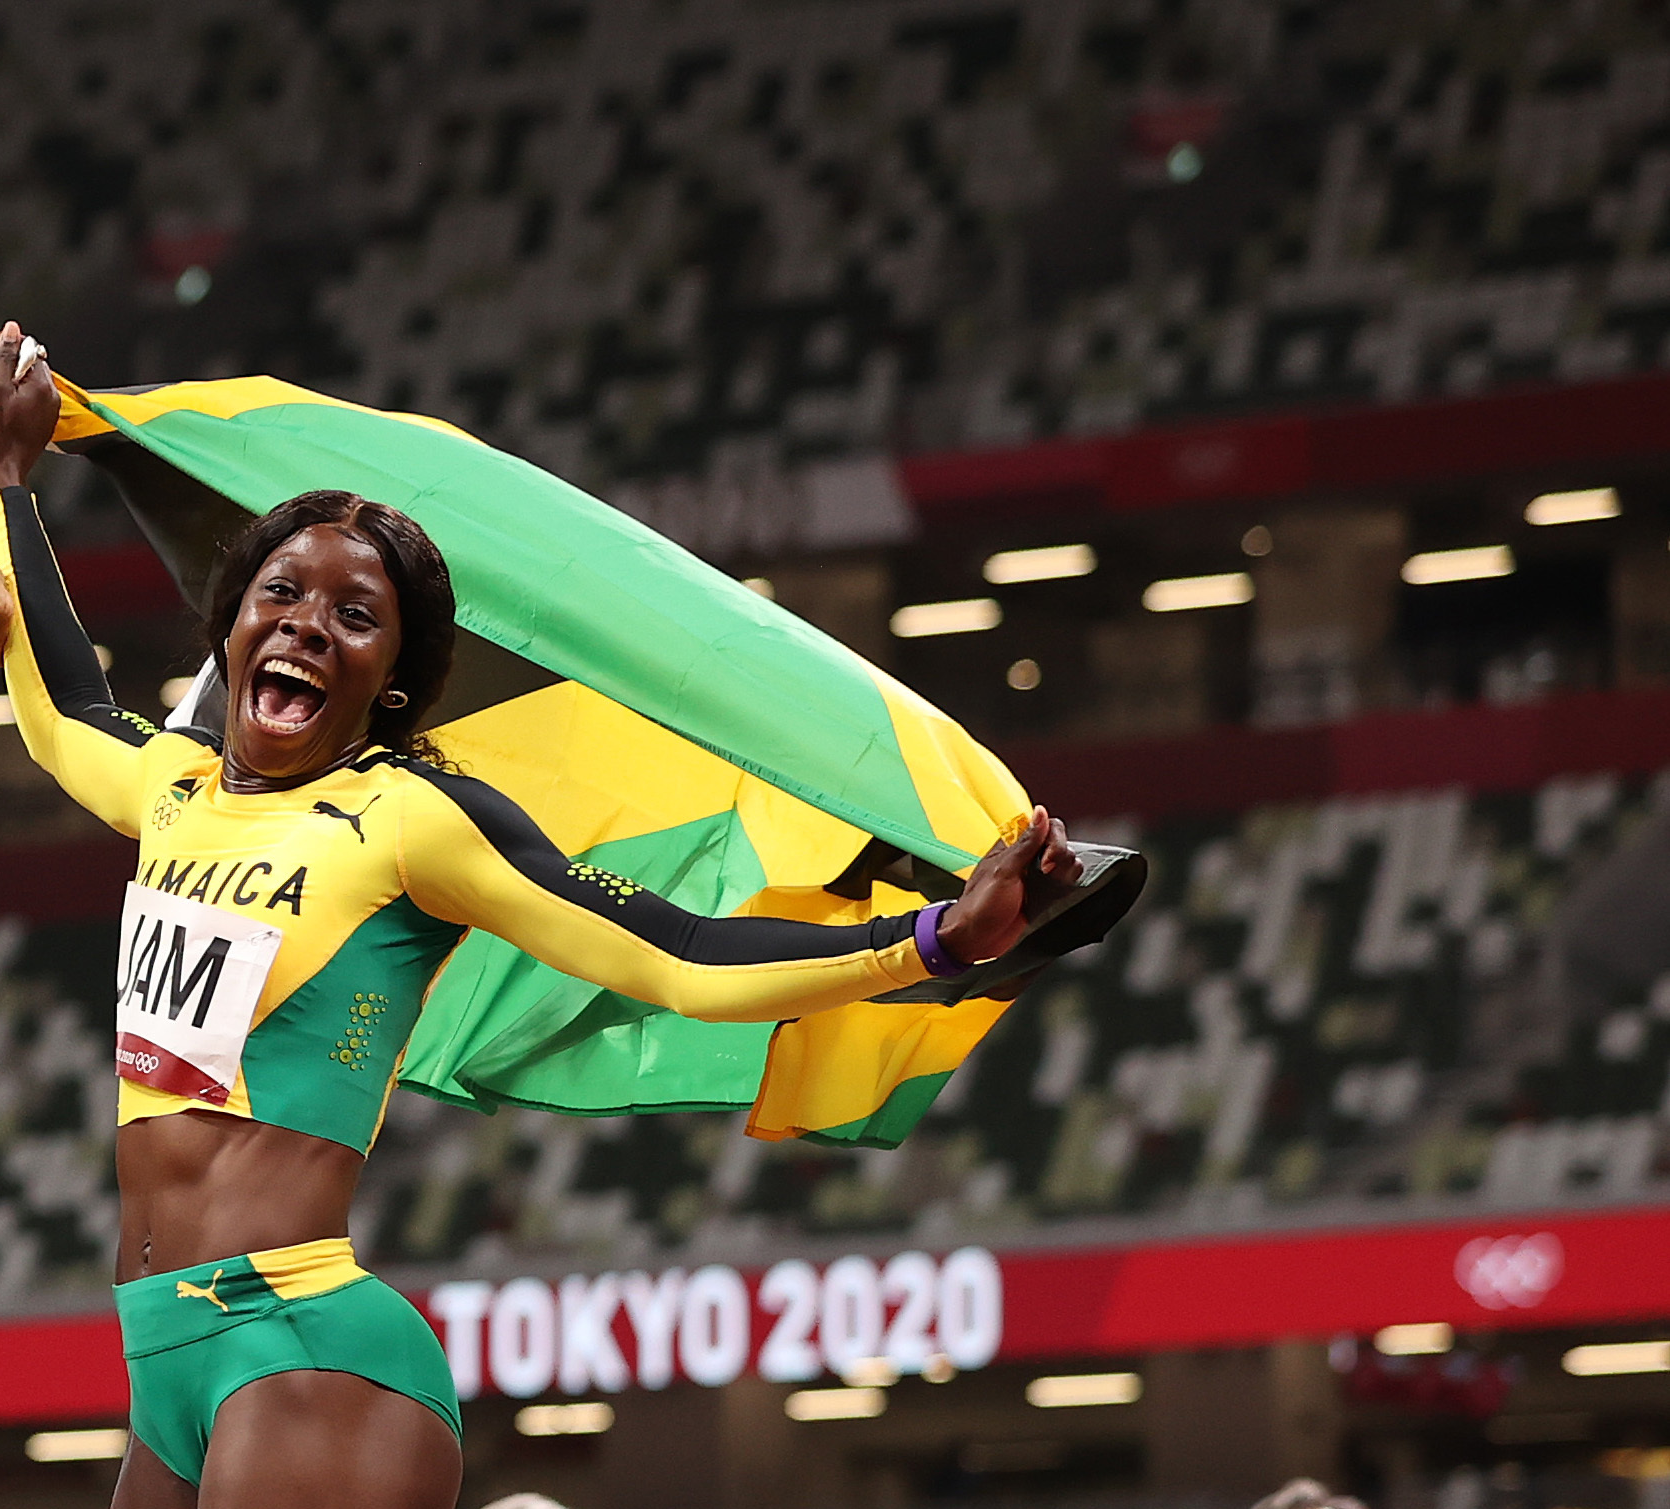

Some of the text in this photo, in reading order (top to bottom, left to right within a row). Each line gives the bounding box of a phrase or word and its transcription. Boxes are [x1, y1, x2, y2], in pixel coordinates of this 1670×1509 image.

[117, 913, 233, 1029] JAM
[429, 1246, 1004, 1401] TOKYO 2020
